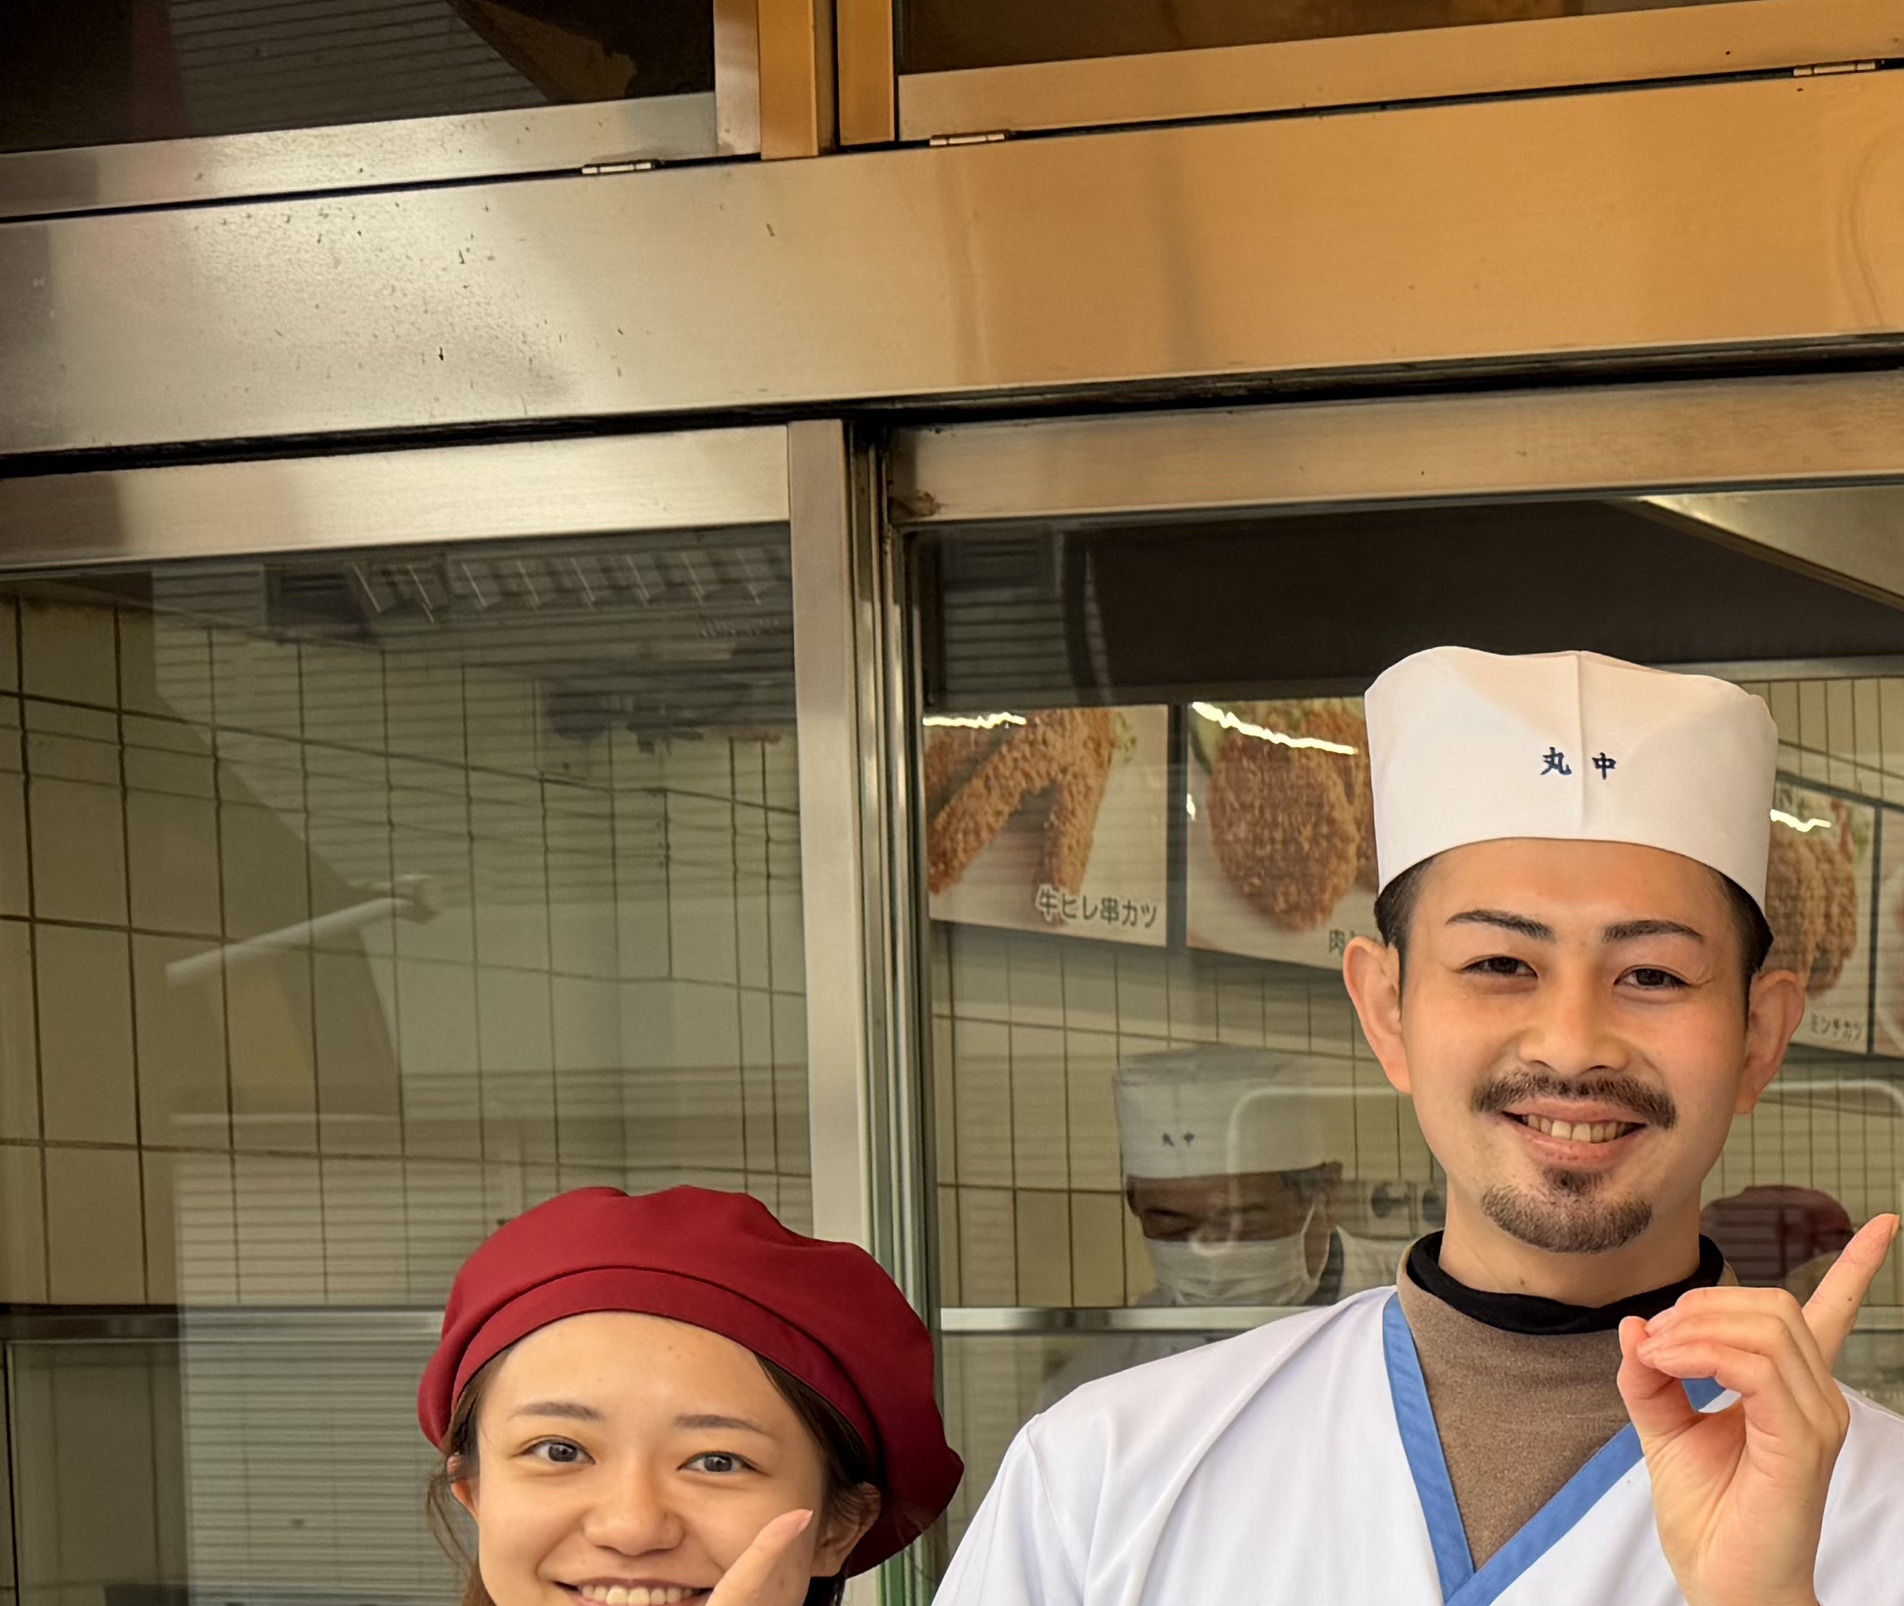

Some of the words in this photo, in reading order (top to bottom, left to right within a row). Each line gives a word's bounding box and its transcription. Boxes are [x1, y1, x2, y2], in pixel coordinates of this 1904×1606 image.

[1539, 746, 1617, 780] 丸中
[1038, 888, 1158, 929] 牛ヒレ串カツ
